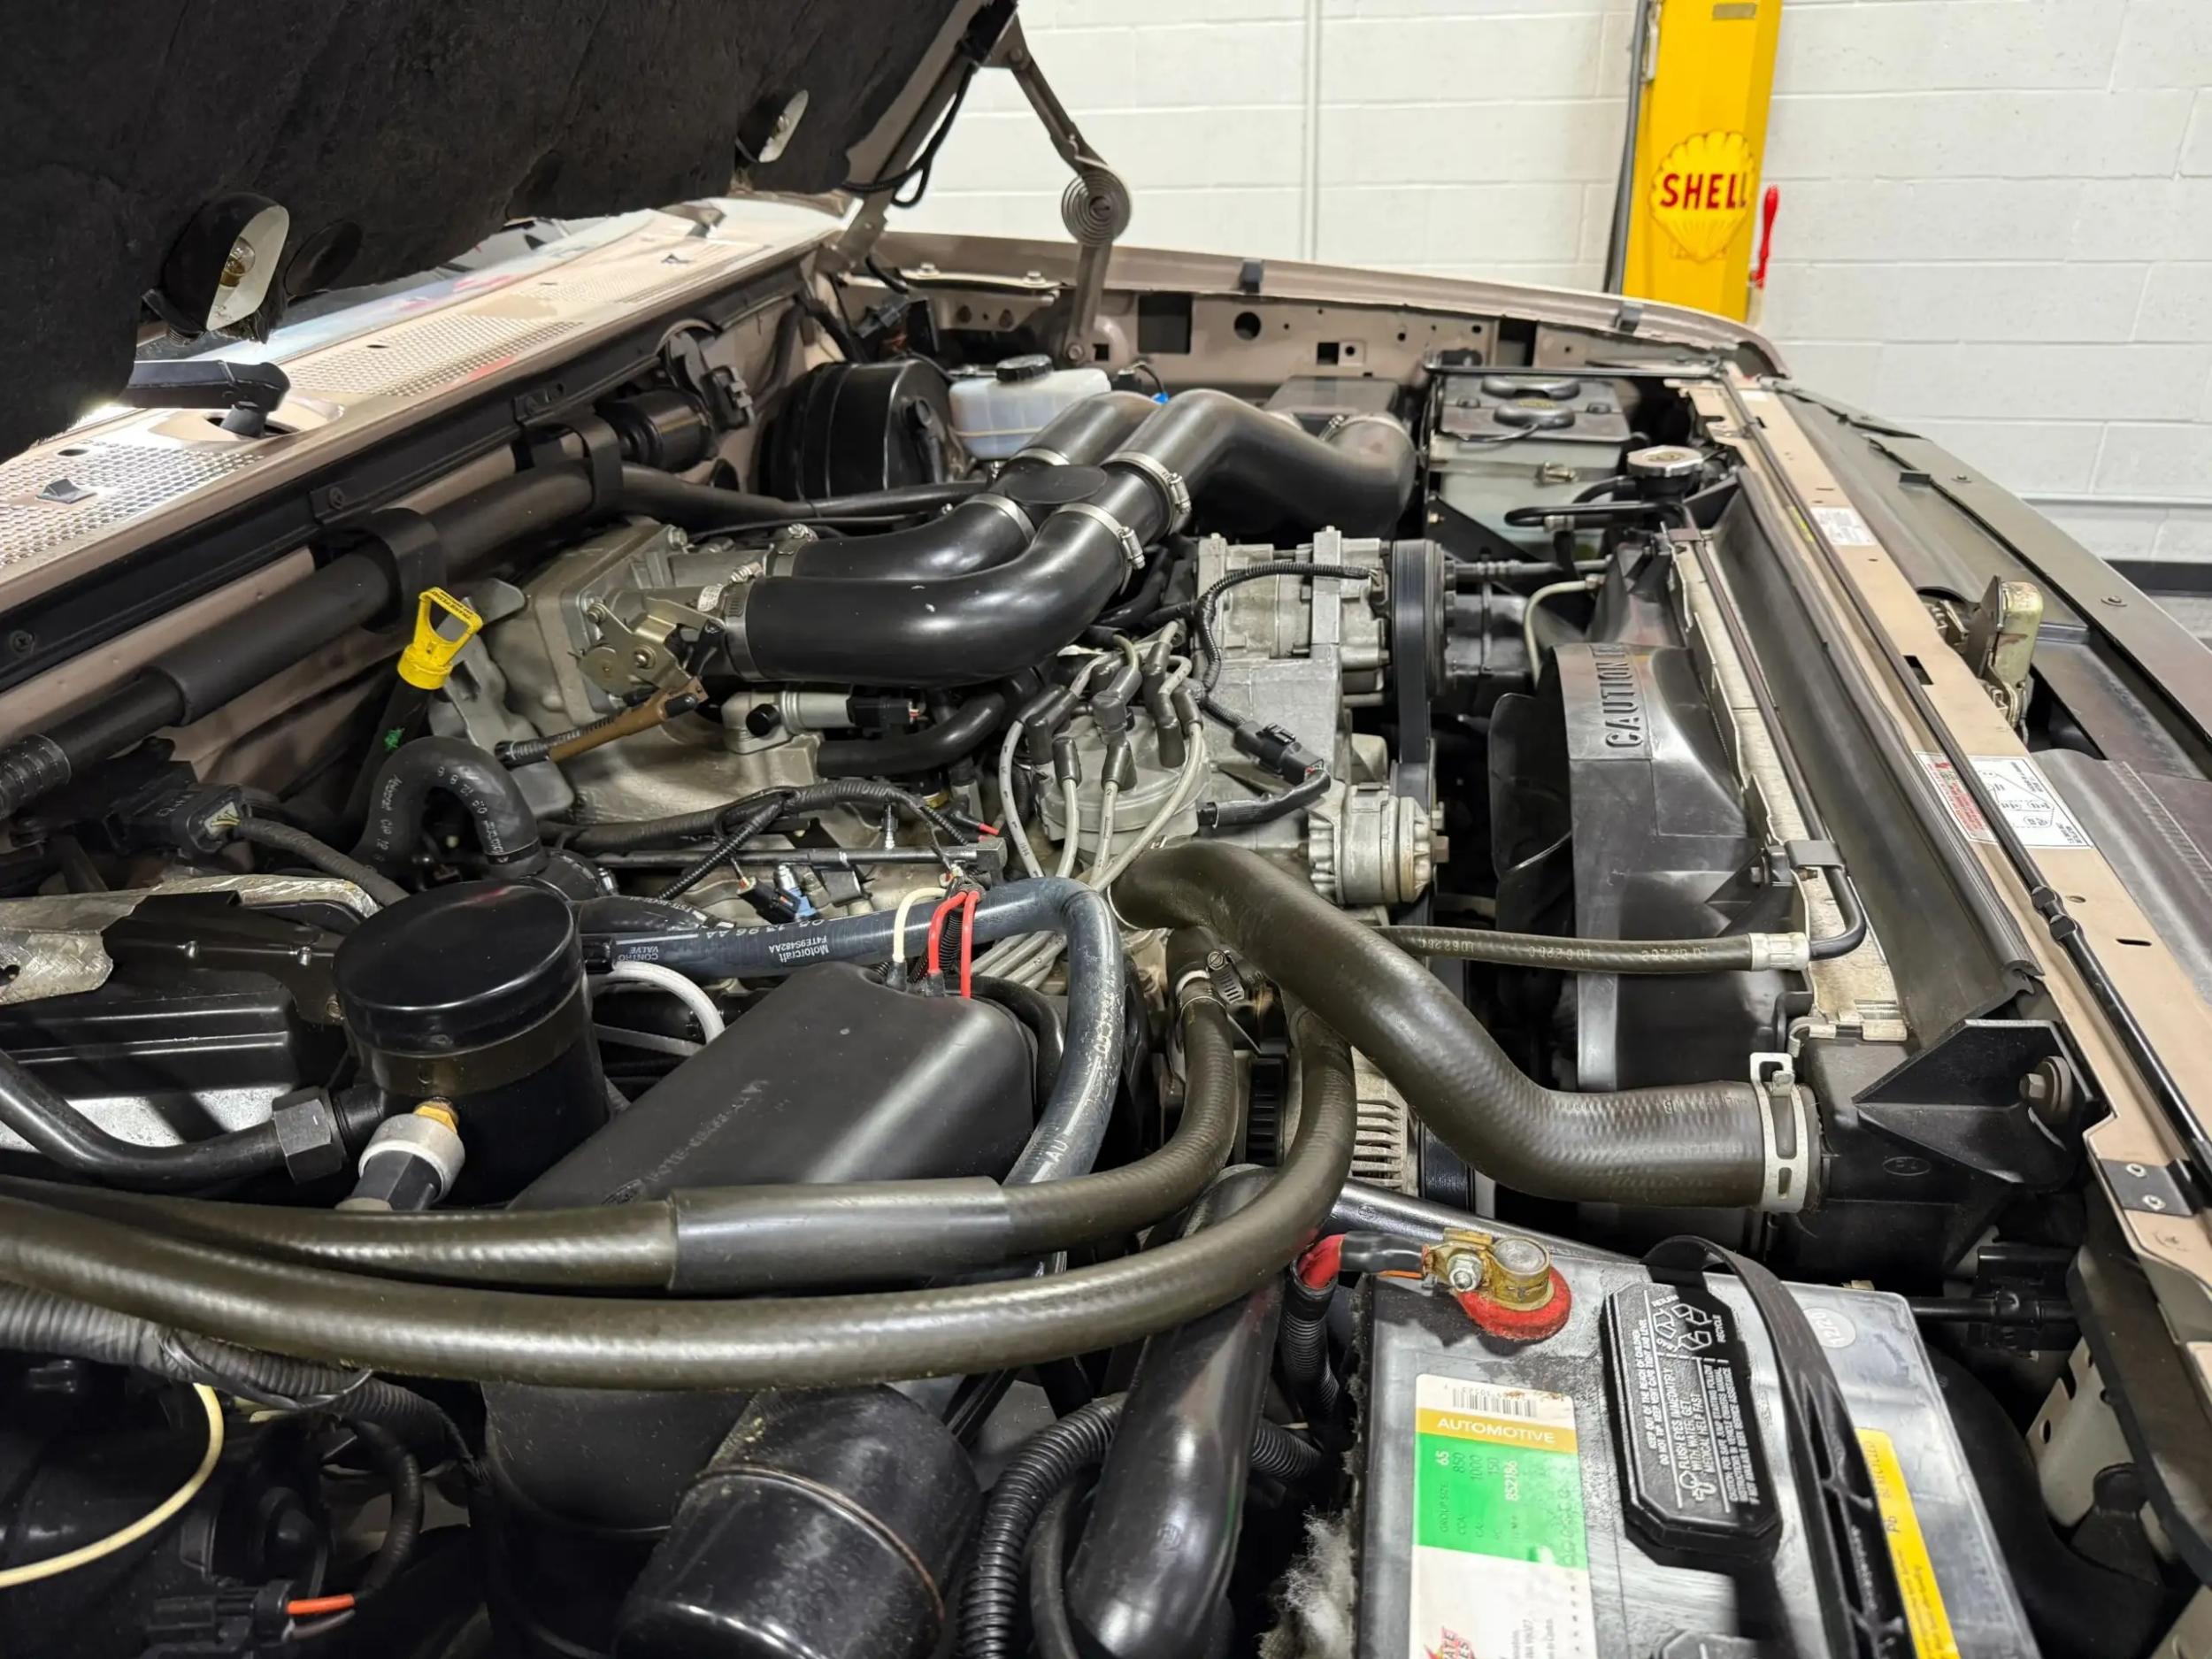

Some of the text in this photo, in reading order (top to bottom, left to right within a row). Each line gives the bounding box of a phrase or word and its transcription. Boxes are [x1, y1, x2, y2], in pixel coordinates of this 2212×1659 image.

[1660, 173, 1747, 209] SHELL
[1595, 663, 1643, 748] CAUTION
[630, 946, 658, 955] VALVE
[779, 943, 829, 963] Motorcraft
[1712, 1314, 1726, 1343] RECYCLE
[1811, 1312, 1846, 1344] 12/20
[1640, 1391, 1651, 1404] THE
[1681, 1401, 1693, 1416] GET
[1709, 1390, 1722, 1420] STARTING
[1642, 1405, 1653, 1416] OF
[1437, 1417, 1555, 1444] AUTOMOTIVE
[1644, 1417, 1655, 1431] OUT
[1671, 1419, 1686, 1441] EYES
[1690, 1393, 1716, 1473] MEDICAL HELP FAST
[1723, 1419, 1736, 1446] VEHICLE
[1646, 1431, 1657, 1449] KEEP
[1656, 1438, 1669, 1455] NOT
[1717, 1439, 1730, 1456] SAFE
[1435, 1450, 1450, 1466] 65
[1452, 1451, 1465, 1474] 850
[1658, 1455, 1670, 1465] DO
[1676, 1442, 1691, 1470] FLUSH
[1688, 1448, 1703, 1471] WITH
[1721, 1456, 1732, 1471] FOR
[1470, 1454, 1484, 1481] 1000
[1504, 1460, 1520, 1502] 852186
